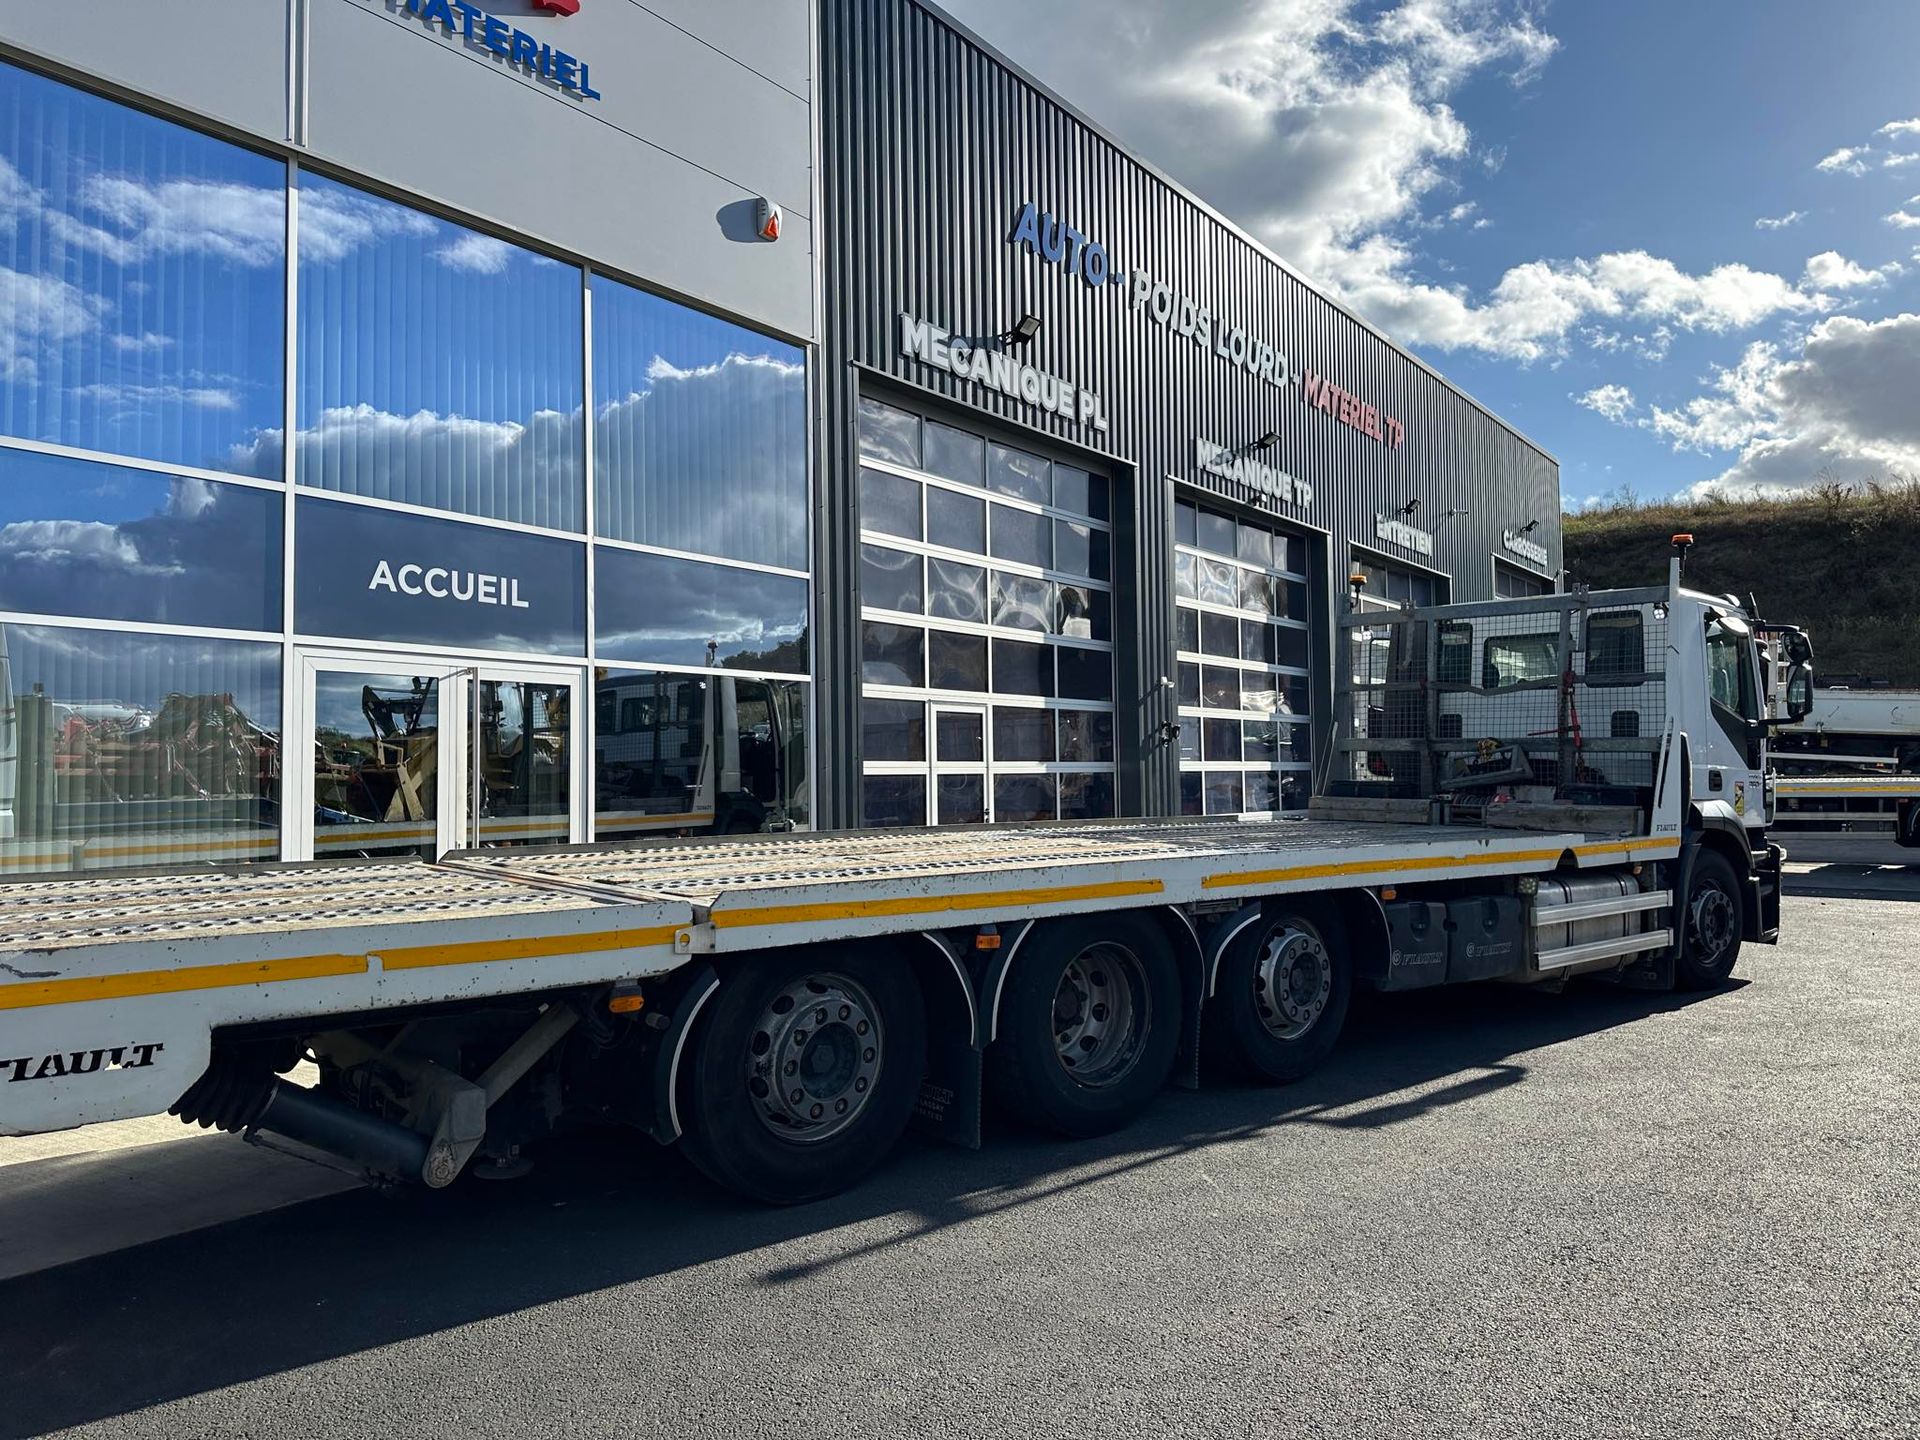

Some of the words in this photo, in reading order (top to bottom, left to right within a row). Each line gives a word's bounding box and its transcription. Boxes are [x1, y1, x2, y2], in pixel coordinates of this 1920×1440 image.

[408, 0, 600, 101] ATERIEL
[1013, 202, 1108, 287] AUTO
[1132, 267, 1211, 347] POIDS
[1216, 318, 1287, 388] LOURD
[1304, 368, 1383, 442] MATERIEL
[1386, 415, 1404, 451] TP
[901, 314, 1074, 419] MECANIQUE
[1079, 387, 1108, 432] PL
[1196, 435, 1293, 503] MECANIQUE
[1295, 477, 1312, 509] TP
[1376, 513, 1432, 557] ENTRETIEN
[368, 560, 530, 608] ACCUEIL
